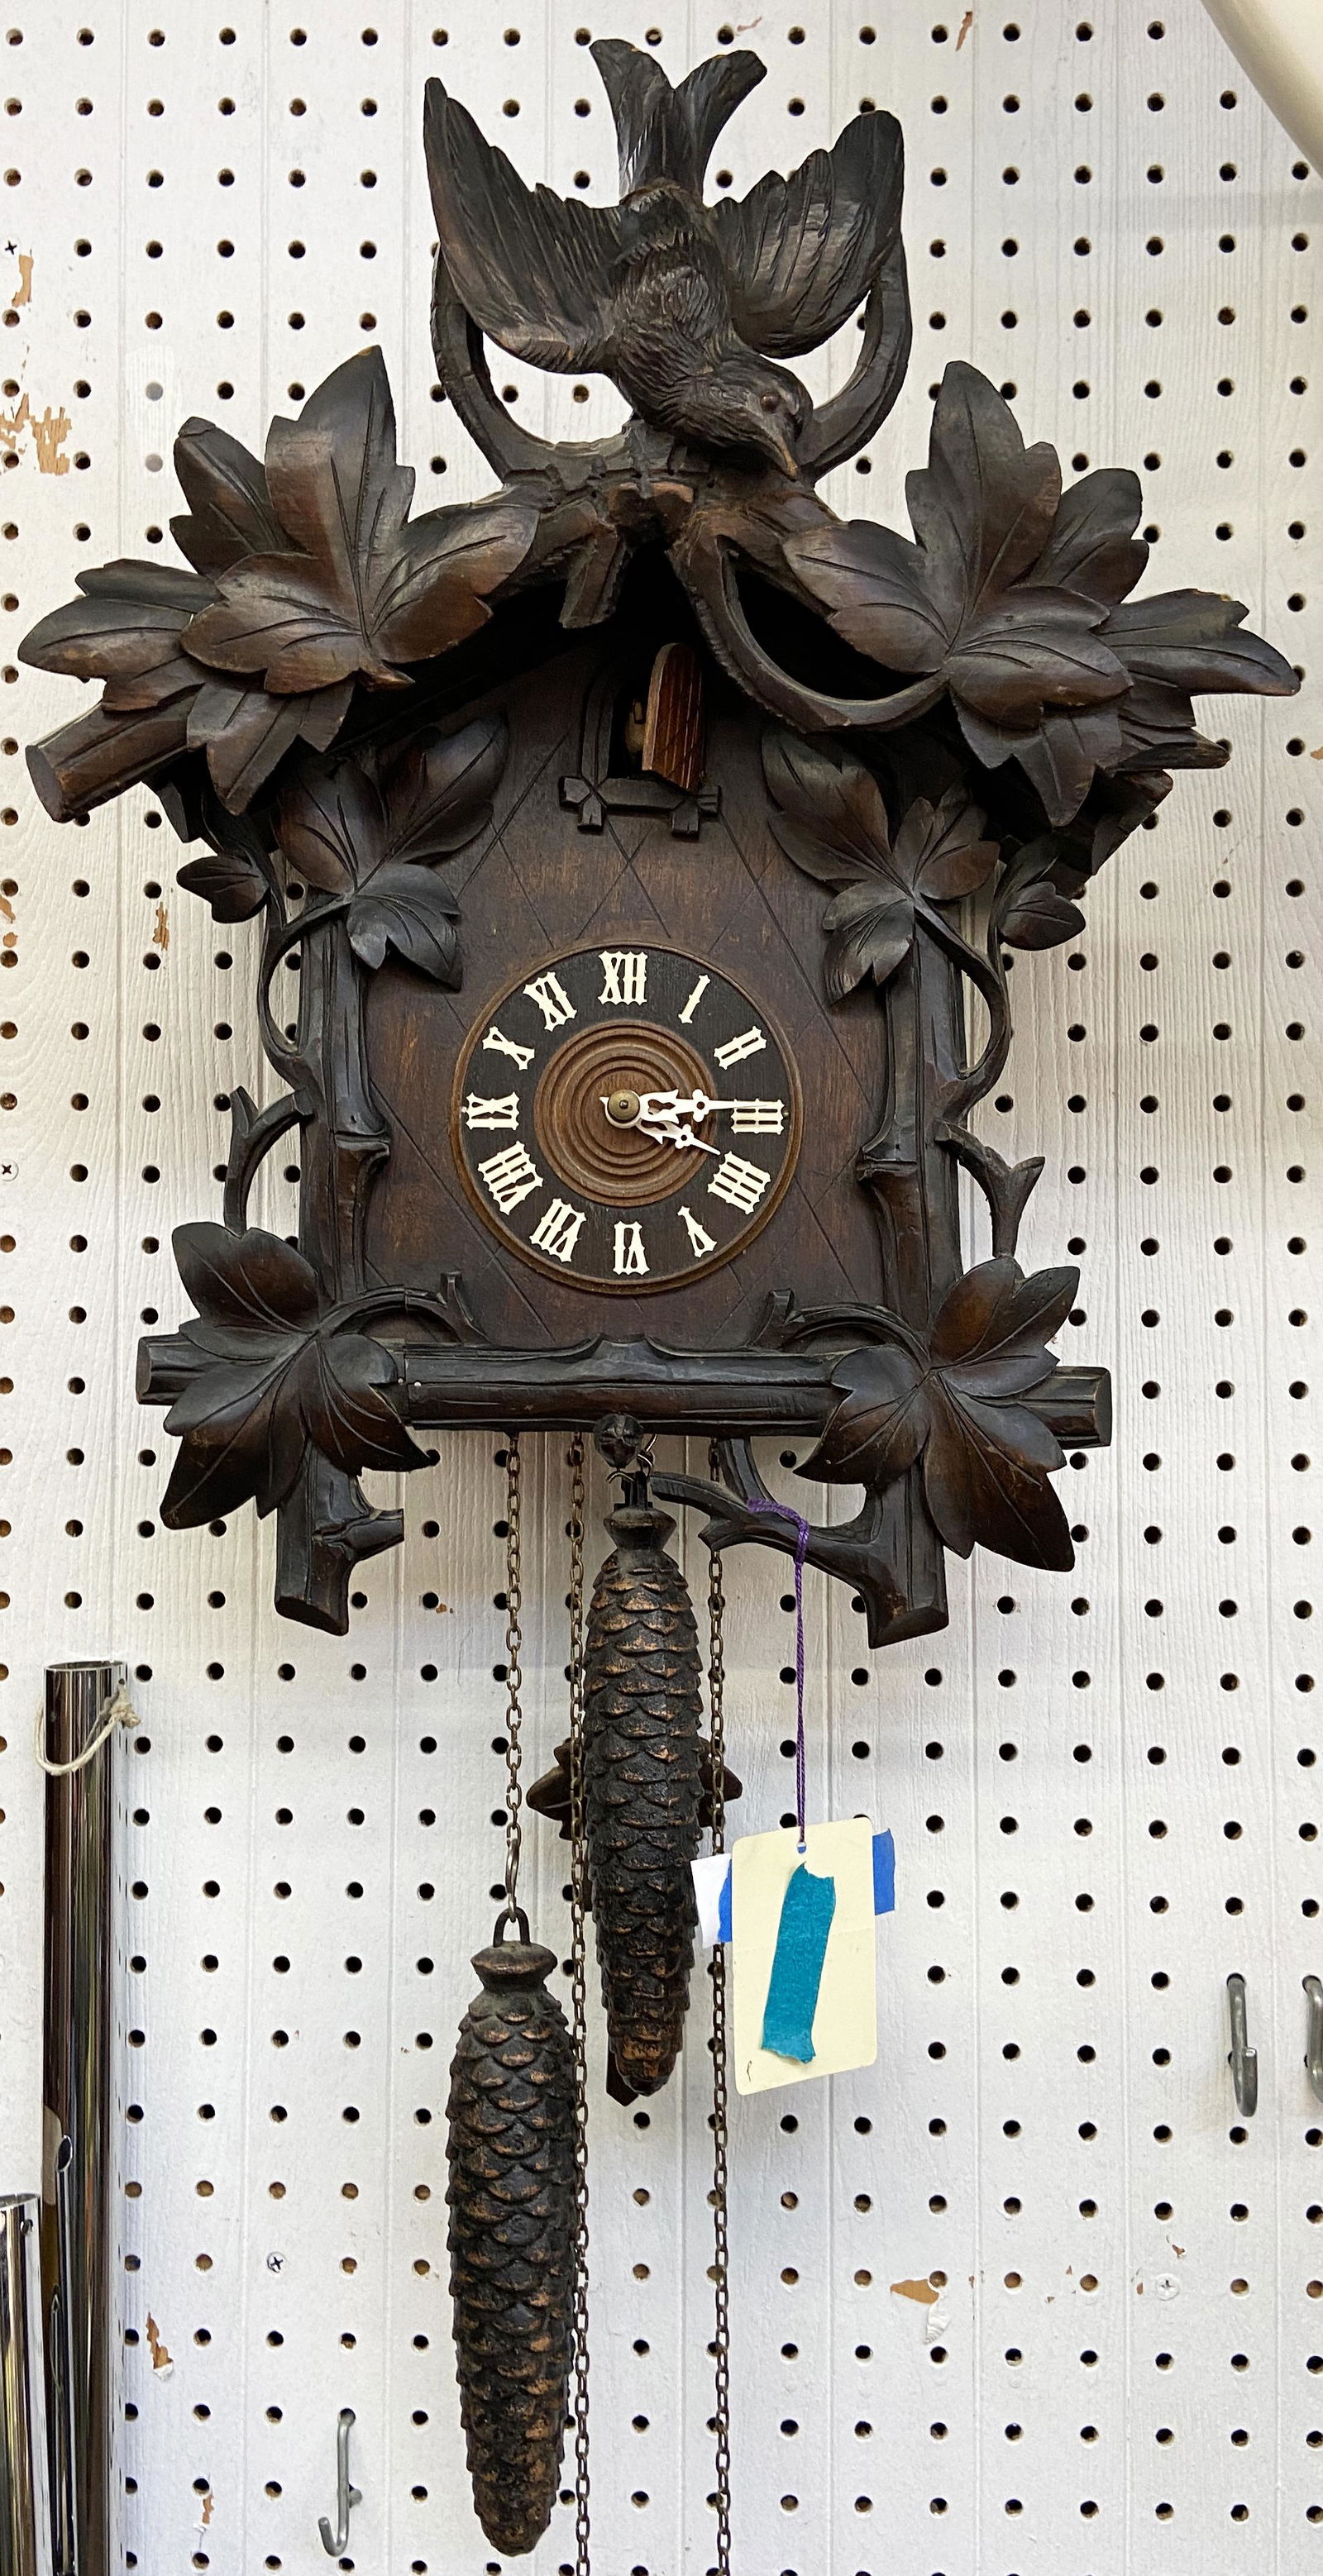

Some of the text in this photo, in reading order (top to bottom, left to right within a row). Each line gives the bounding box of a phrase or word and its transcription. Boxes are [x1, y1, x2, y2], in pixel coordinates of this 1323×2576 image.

[523, 971, 578, 1032] XI
[598, 951, 648, 1005] XII
[678, 974, 711, 1024] I
[482, 1026, 535, 1071] X
[714, 1026, 767, 1070] II
[466, 1091, 520, 1131] IX
[730, 1098, 786, 1135] III
[477, 1141, 544, 1216] VIII
[707, 1151, 771, 1215] IIII
[529, 1198, 586, 1262] VII
[613, 1220, 650, 1276] VI
[677, 1205, 718, 1258] V
